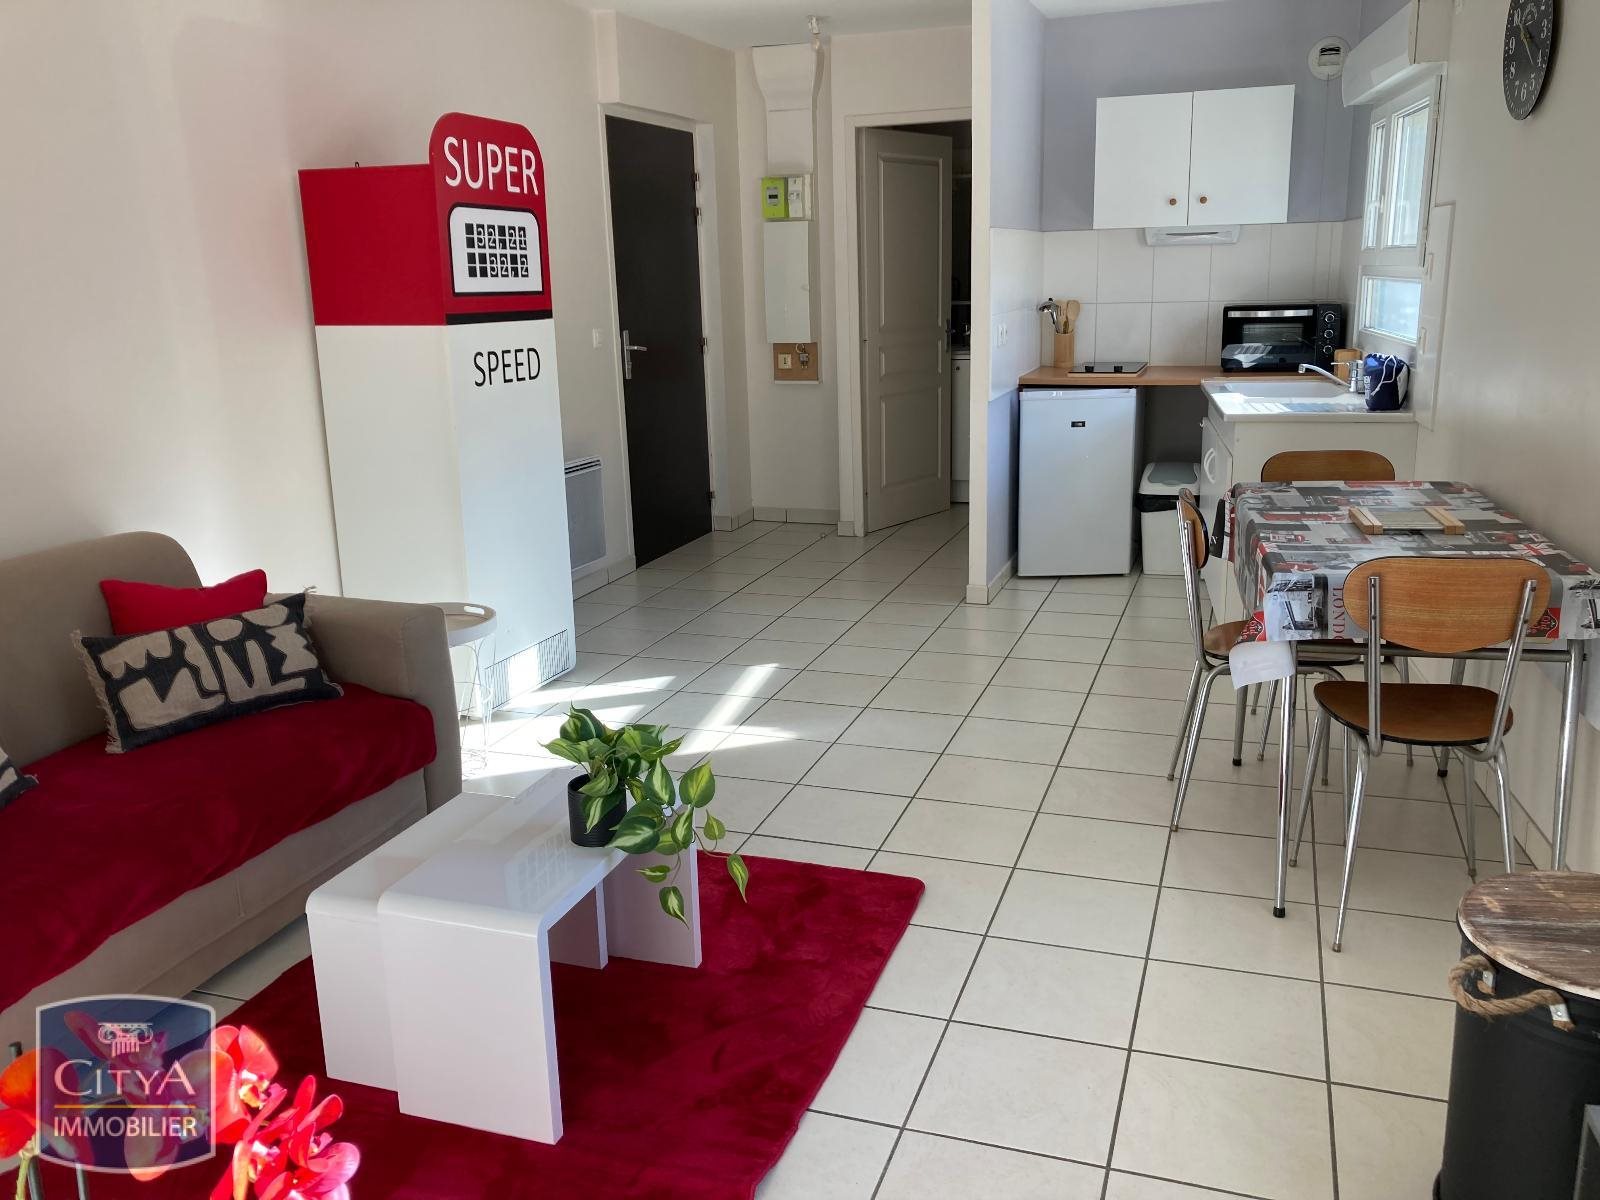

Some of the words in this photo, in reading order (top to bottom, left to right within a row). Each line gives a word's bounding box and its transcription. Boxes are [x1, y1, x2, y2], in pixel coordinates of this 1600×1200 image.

[1509, 37, 1516, 54] 9
[1509, 62, 1516, 79] 8
[1520, 83, 1527, 101] 6
[443, 136, 539, 196] SUPER
[473, 347, 541, 387] SPEED
